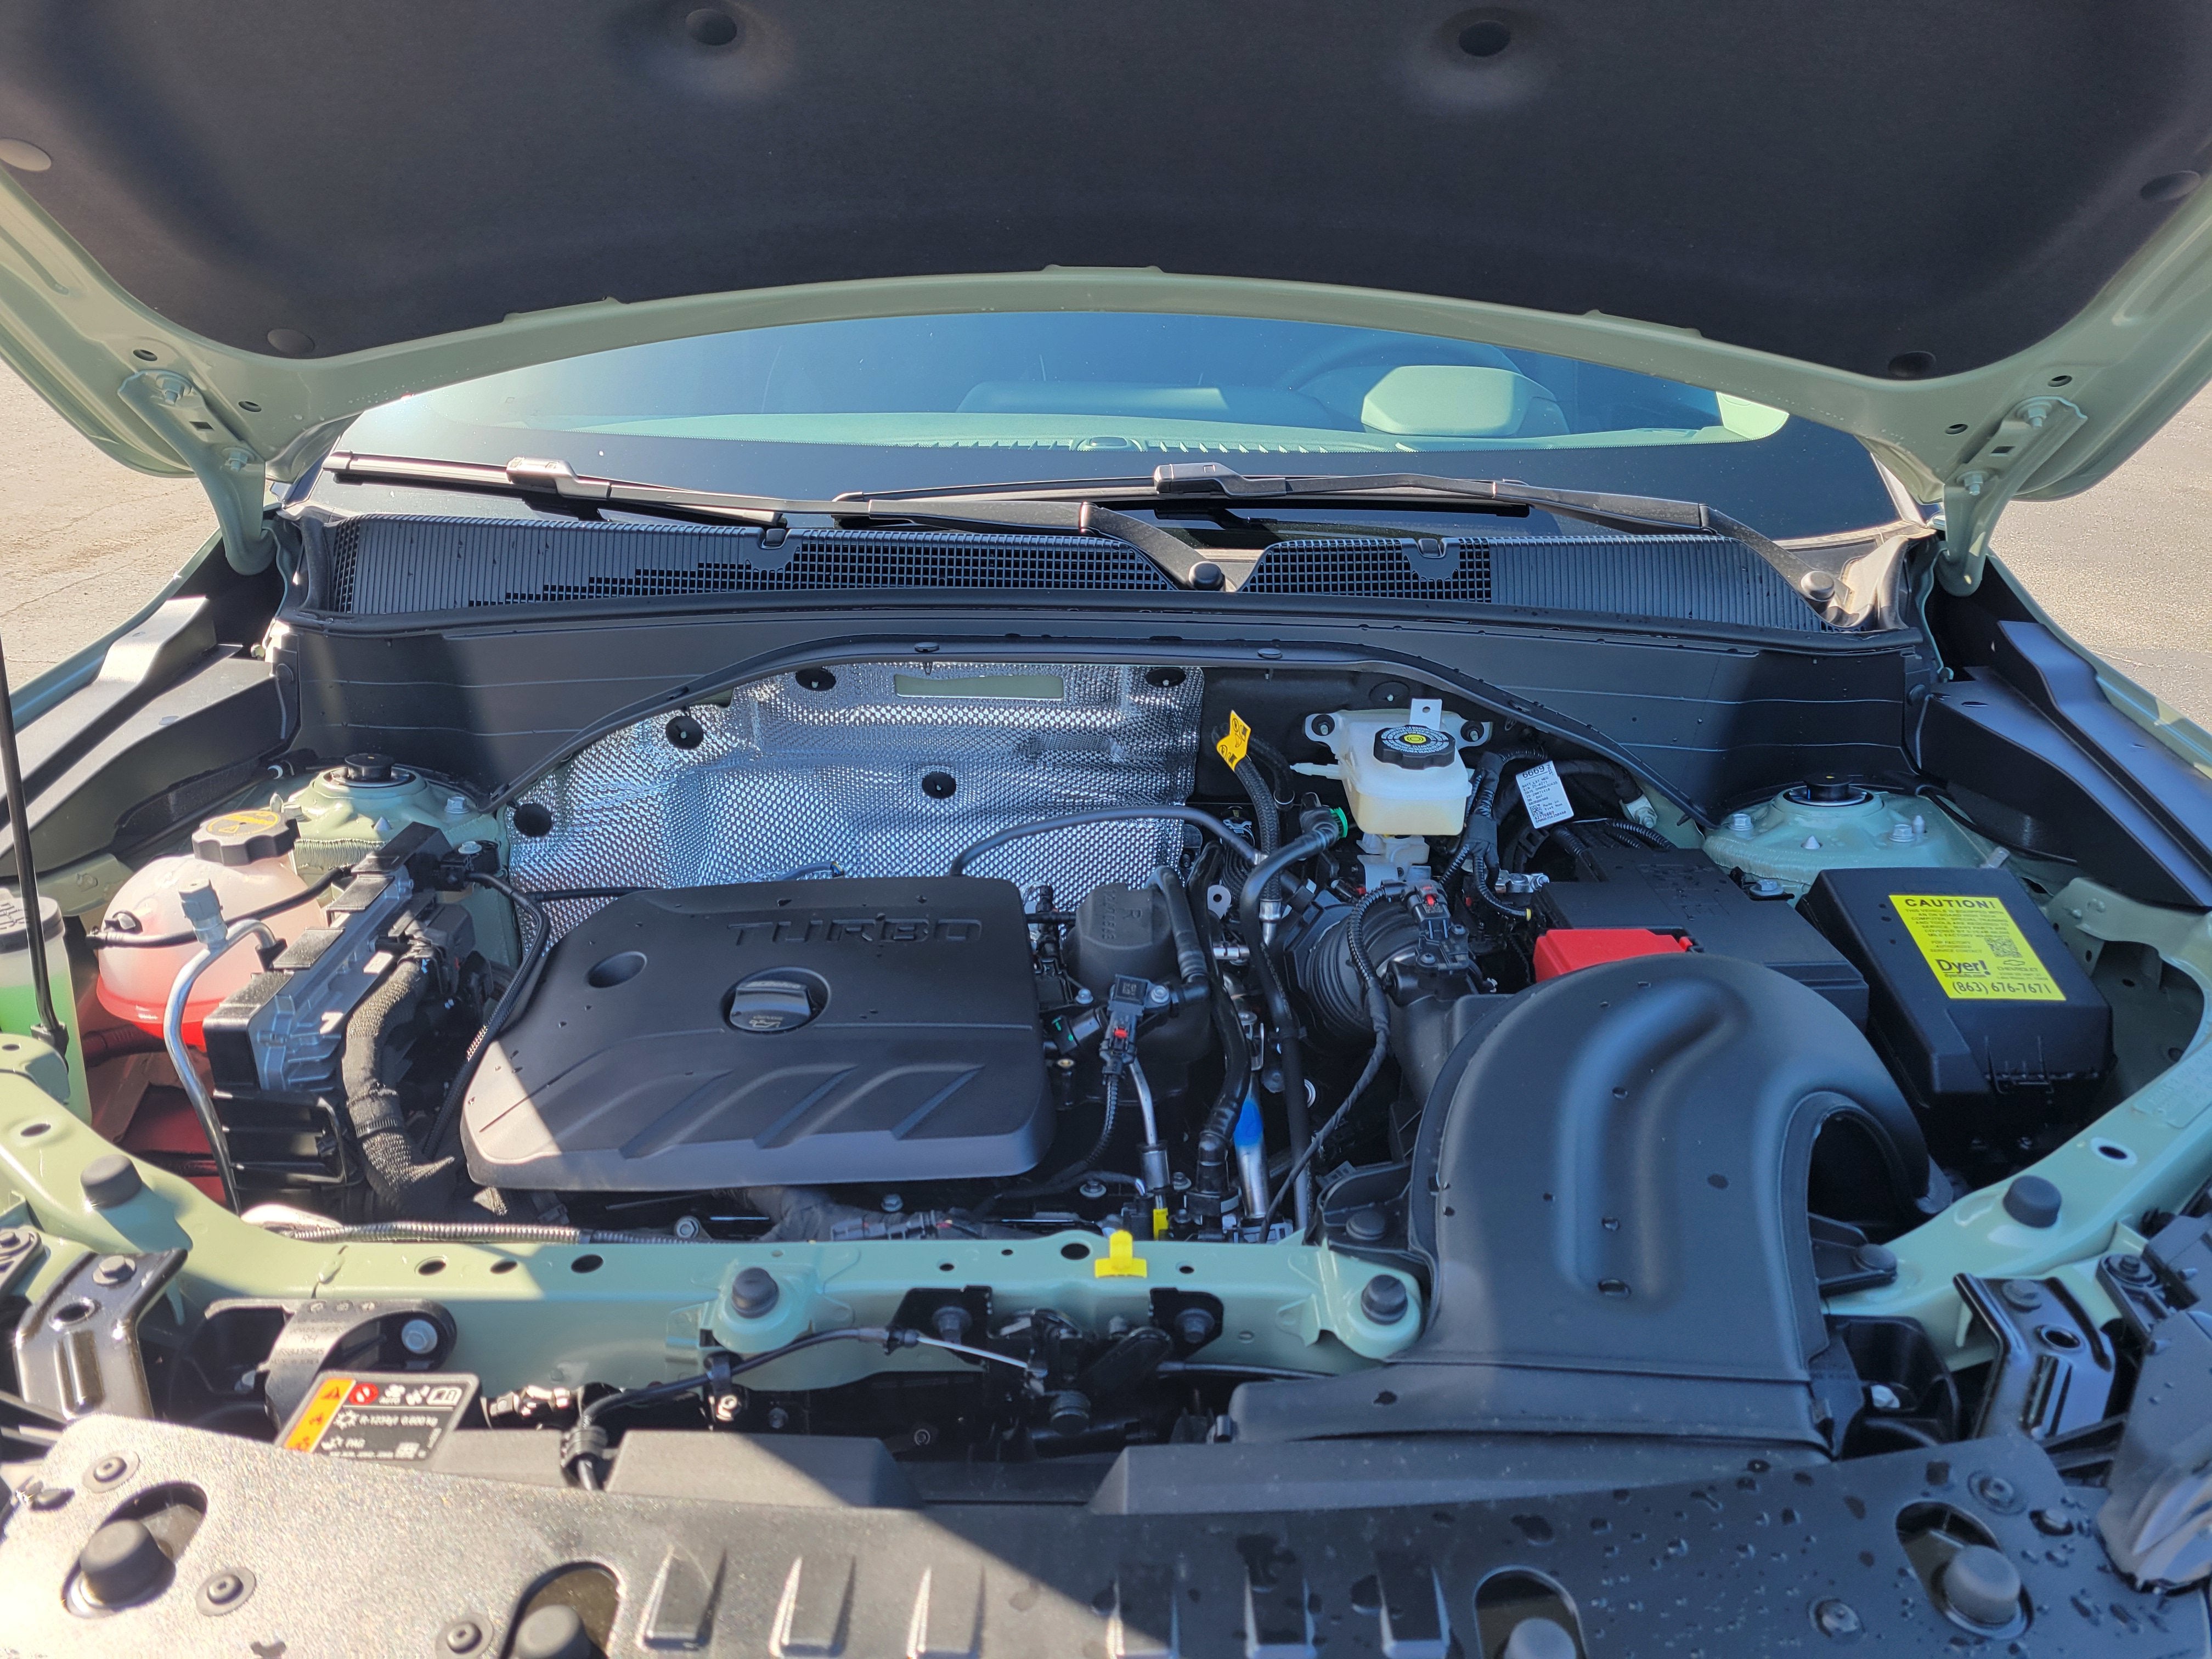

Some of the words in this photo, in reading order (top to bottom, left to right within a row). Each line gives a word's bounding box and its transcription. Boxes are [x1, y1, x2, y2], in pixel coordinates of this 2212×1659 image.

[1522, 765, 1545, 778] 6669
[1905, 899, 1996, 909] CAUTION!
[727, 918, 982, 946] TURBO
[1935, 959, 1991, 975] Dyer!
[1953, 981, 1989, 995] (863)
[1991, 982, 2051, 994] 676-7671
